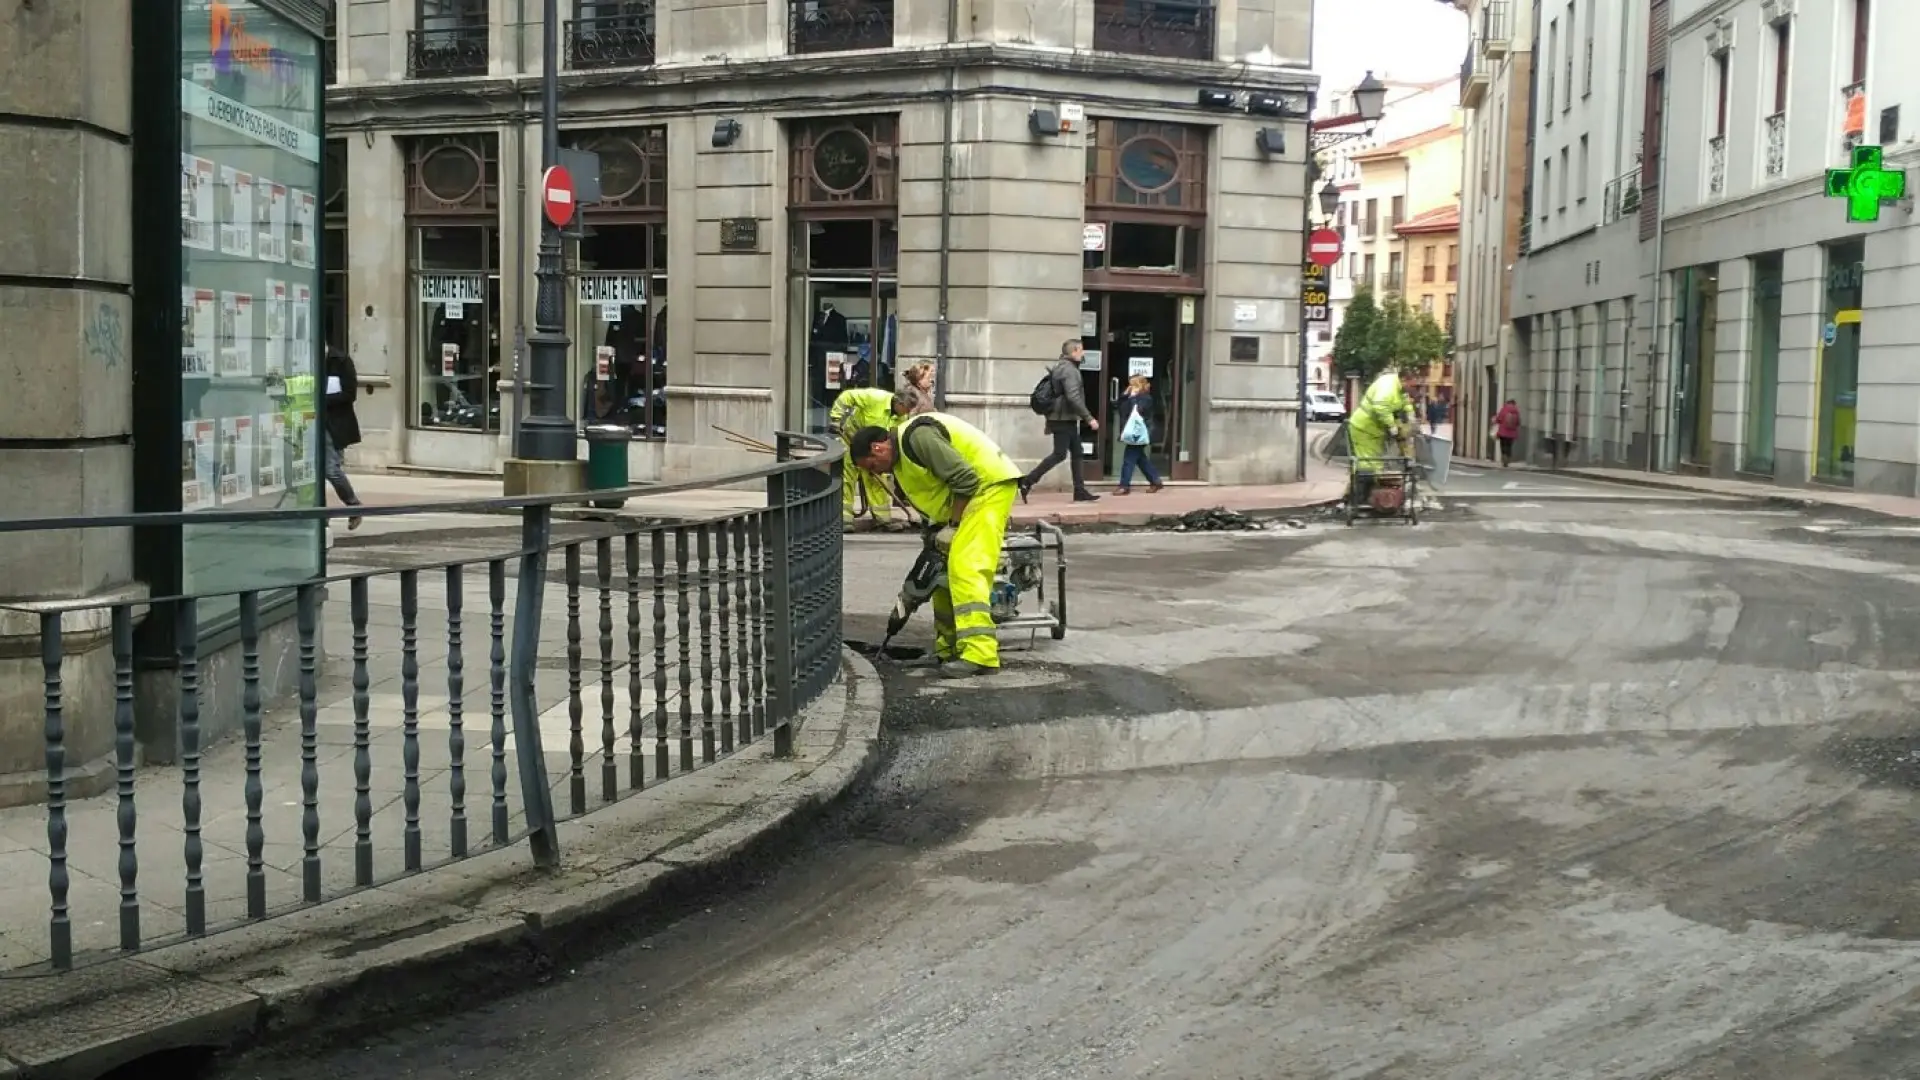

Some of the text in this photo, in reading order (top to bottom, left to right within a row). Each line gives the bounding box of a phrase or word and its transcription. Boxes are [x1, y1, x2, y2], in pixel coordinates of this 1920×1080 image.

[207, 95, 298, 149] QUEREMOS PISOS PARA VENDER
[422, 275, 457, 299] REMATE
[580, 275, 618, 300] REMATE
